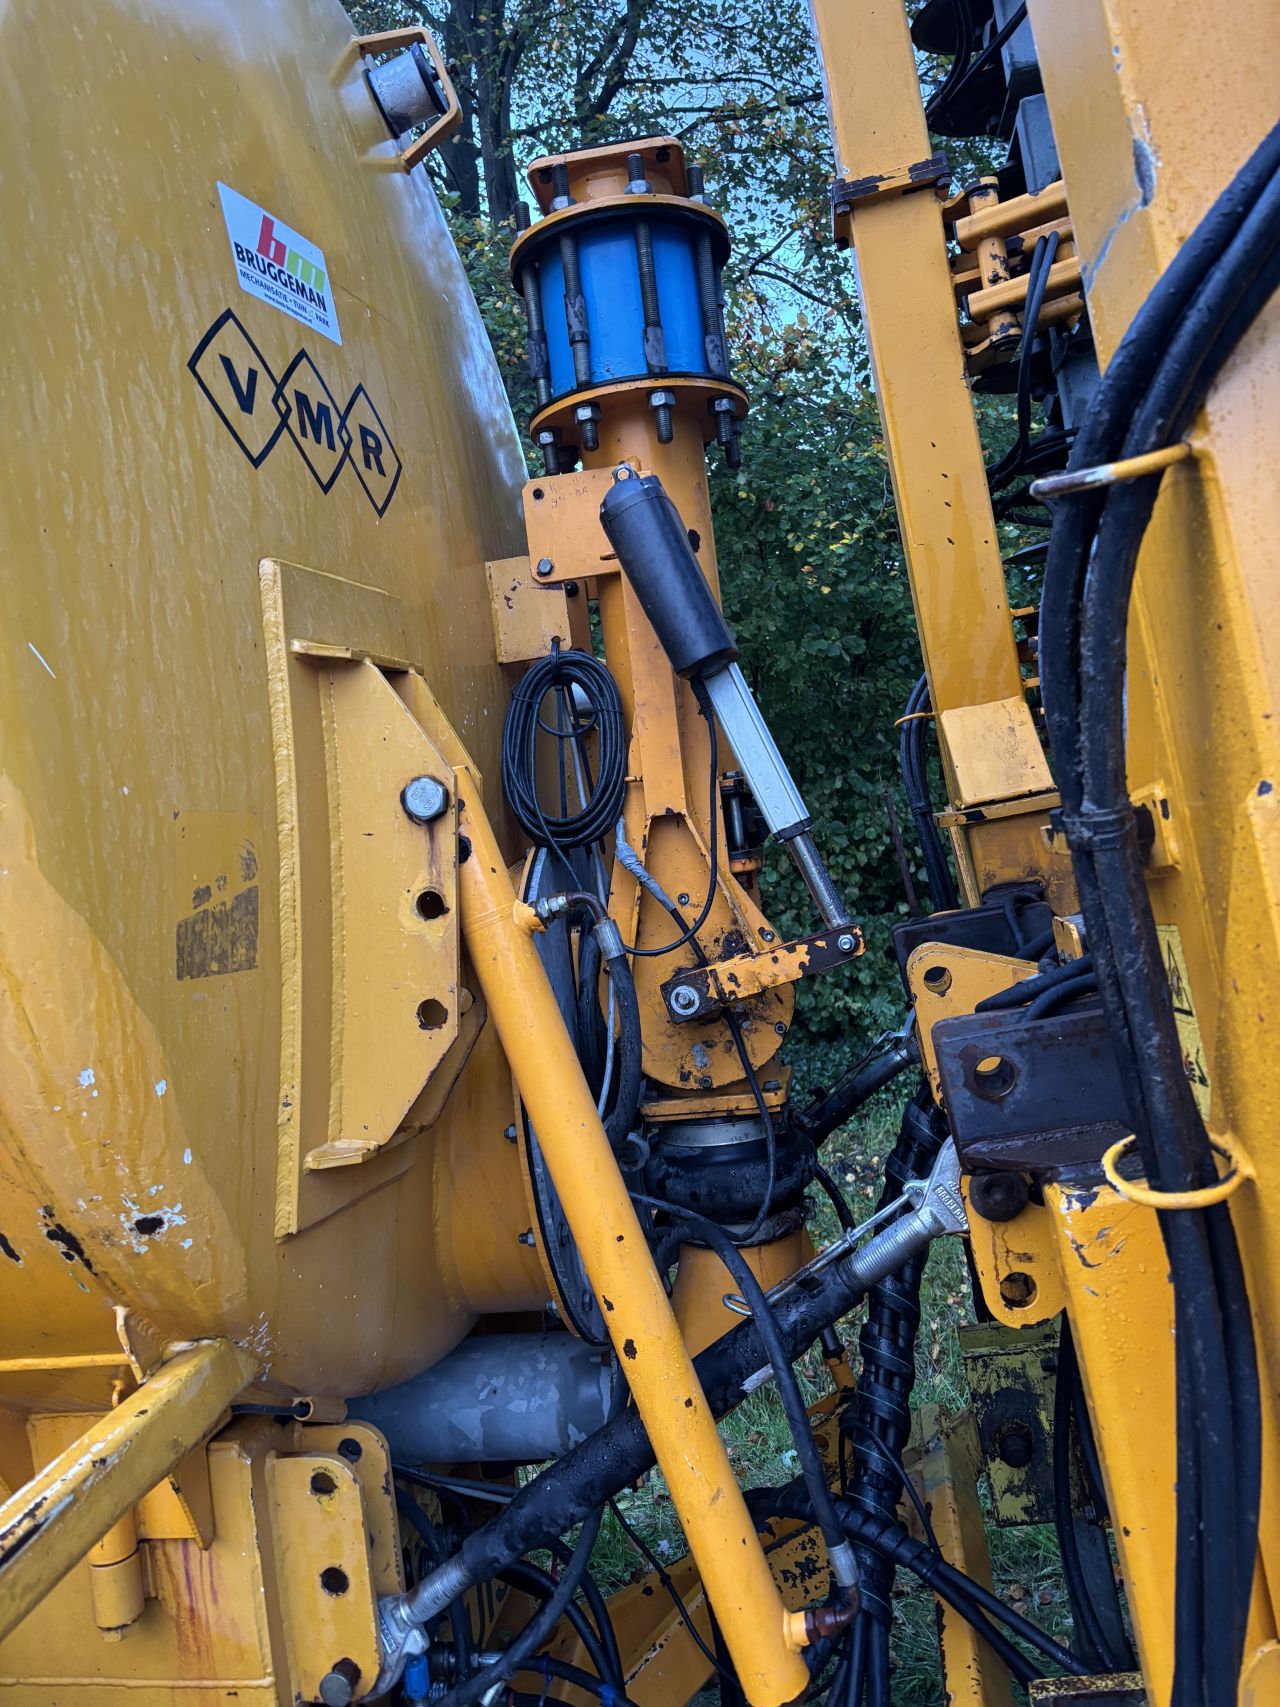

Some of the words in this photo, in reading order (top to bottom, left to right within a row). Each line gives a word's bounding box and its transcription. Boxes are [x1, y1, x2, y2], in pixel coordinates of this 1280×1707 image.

[234, 241, 327, 313] BRUGGEMAN
[240, 269, 288, 303] MECHANISATIE
[293, 300, 308, 313] TUIN
[315, 312, 330, 328] PARK
